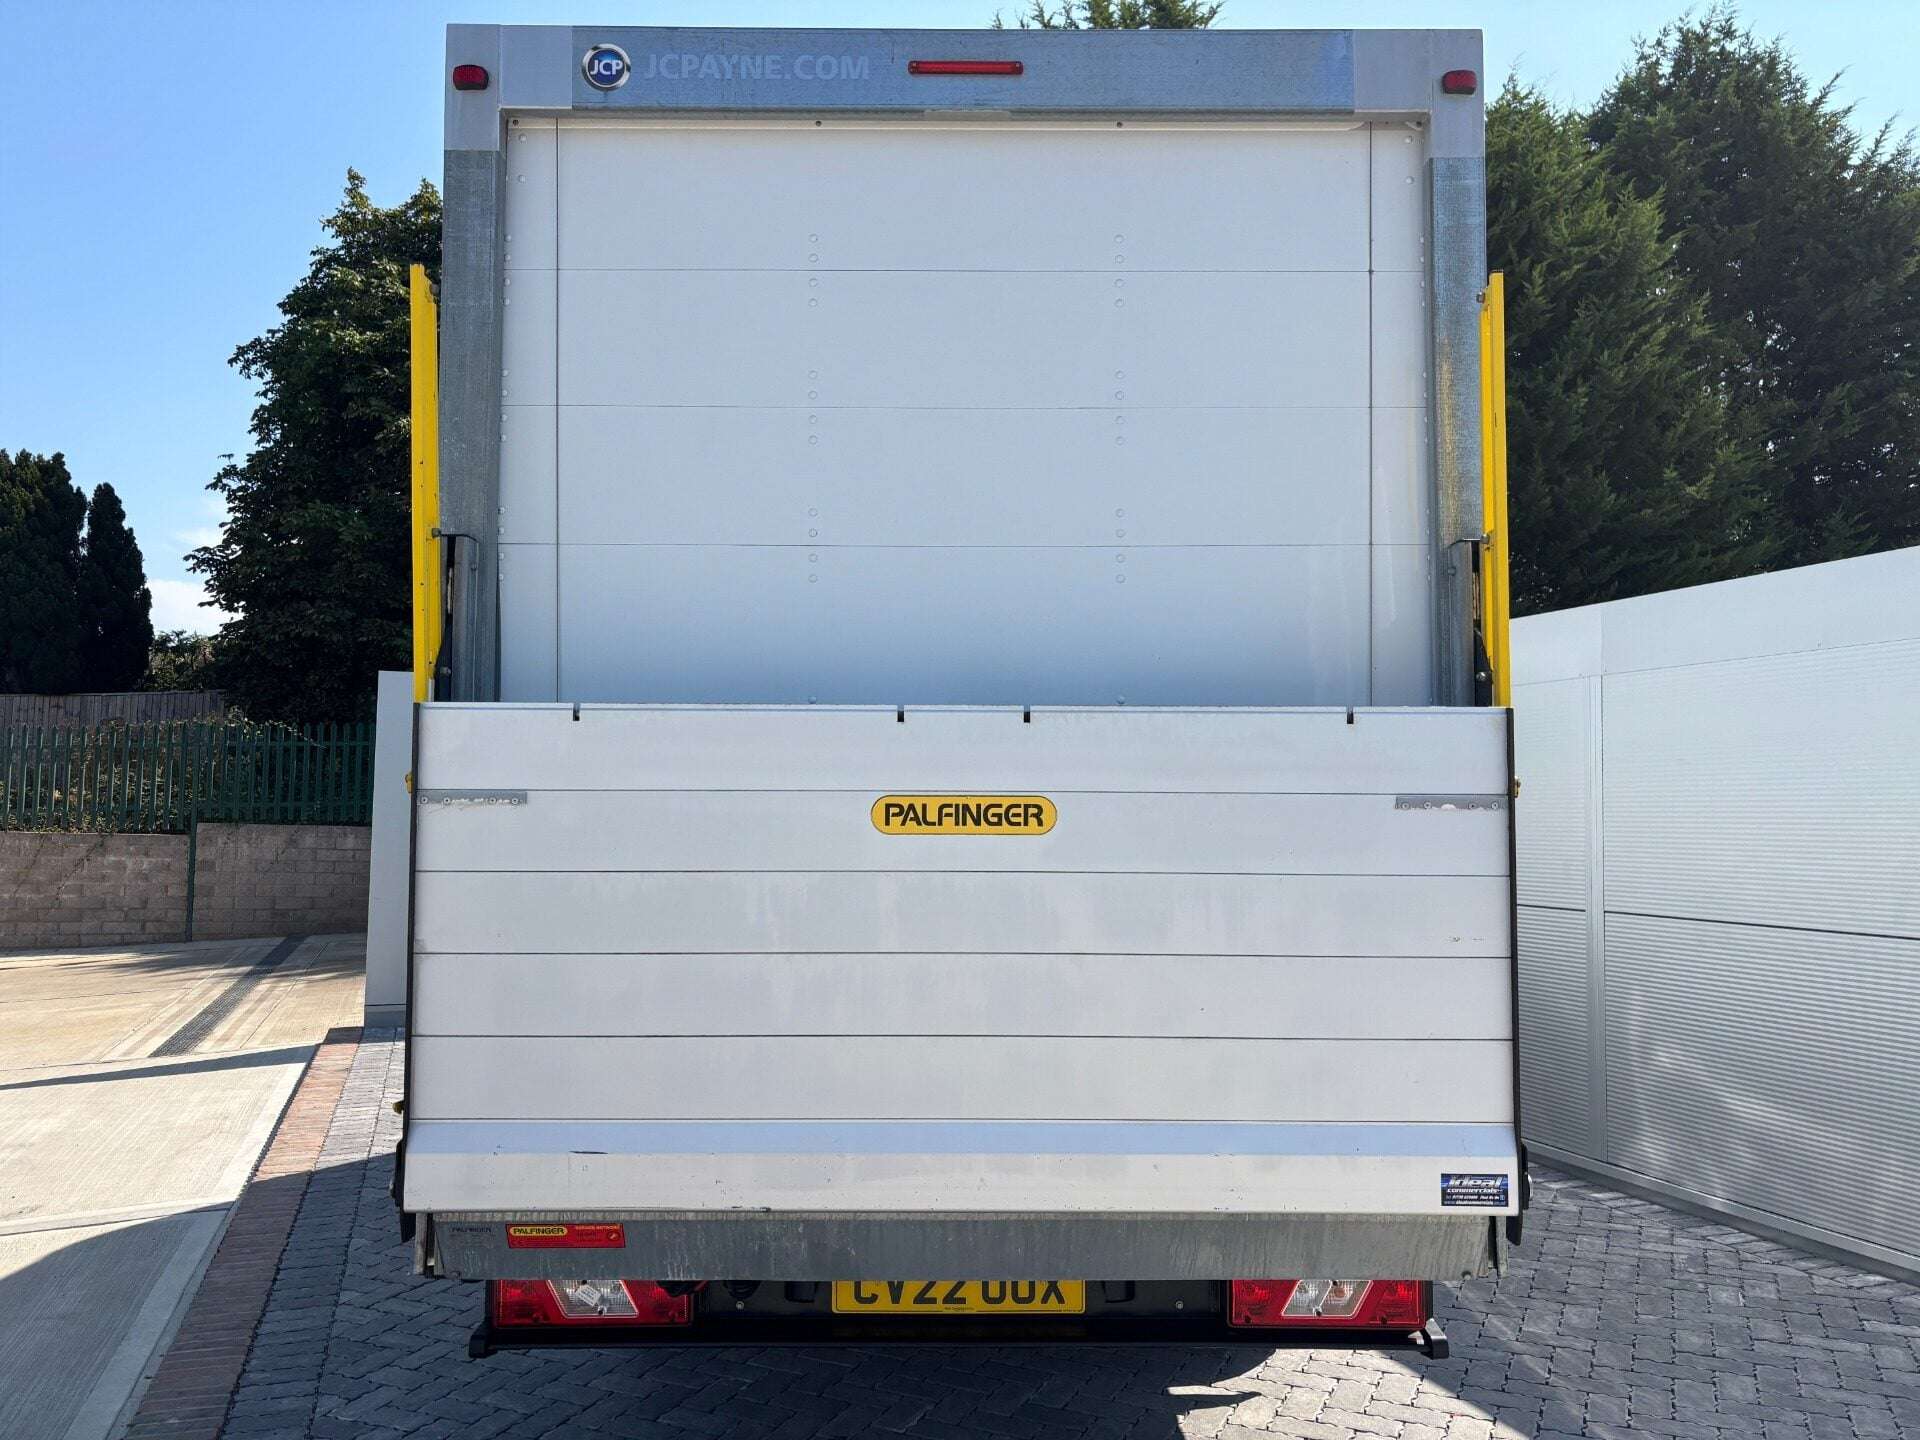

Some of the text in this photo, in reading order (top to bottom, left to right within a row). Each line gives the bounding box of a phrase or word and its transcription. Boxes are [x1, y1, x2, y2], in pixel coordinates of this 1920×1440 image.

[590, 54, 870, 81] JCP JCPAYNE.COM
[884, 803, 1044, 827] PALFINGER
[513, 1227, 565, 1235] PALFINGER
